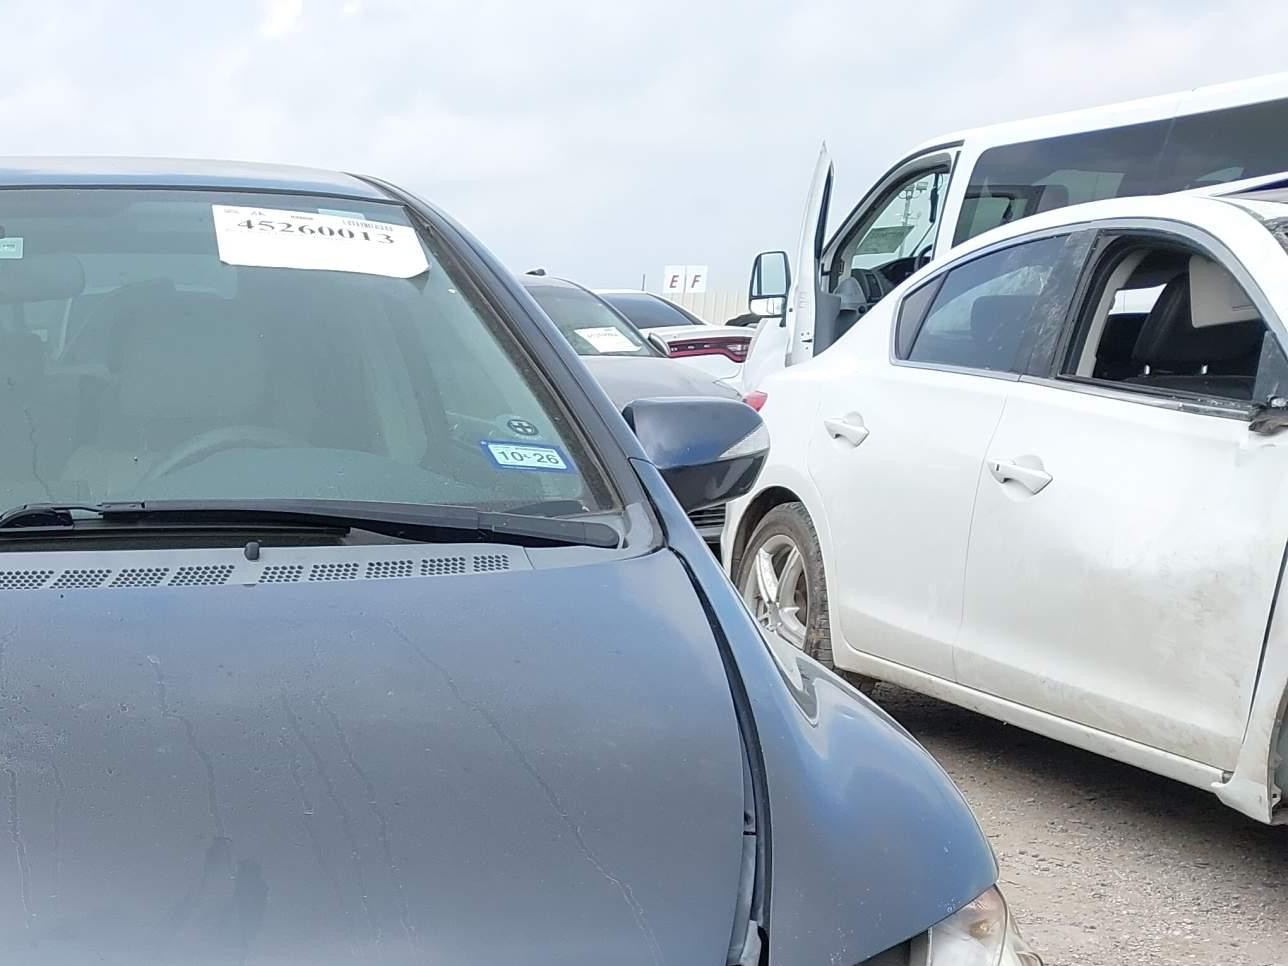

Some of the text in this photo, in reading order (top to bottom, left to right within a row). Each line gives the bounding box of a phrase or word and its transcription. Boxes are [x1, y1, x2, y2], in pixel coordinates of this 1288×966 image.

[237, 218, 395, 244] 45260013
[669, 274, 680, 289] E
[691, 274, 702, 289] F
